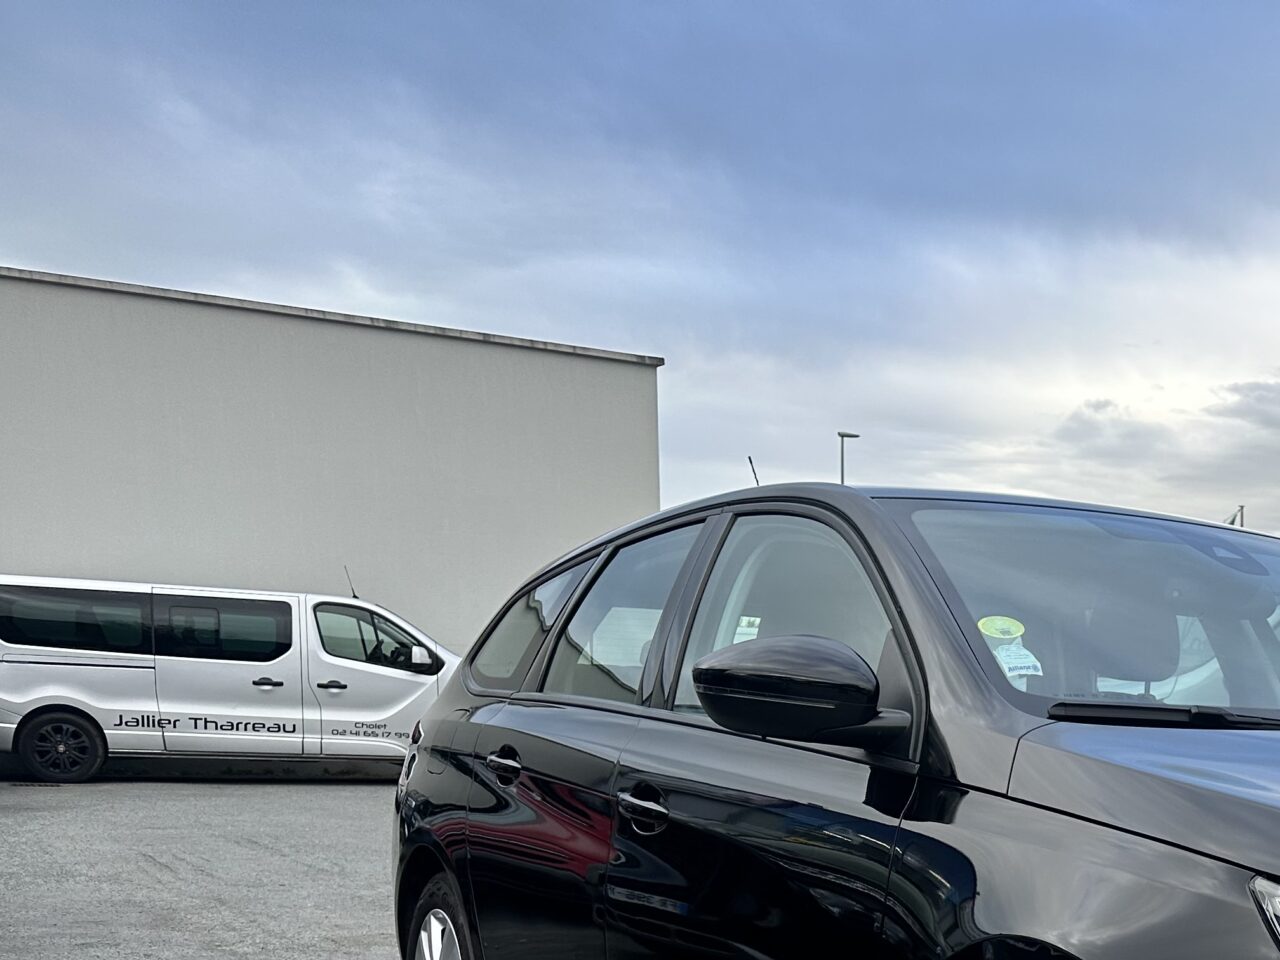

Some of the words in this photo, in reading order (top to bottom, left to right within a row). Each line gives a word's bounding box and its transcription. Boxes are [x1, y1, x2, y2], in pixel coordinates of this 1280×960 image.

[113, 714, 180, 729] Jallier
[188, 717, 297, 734] Tharreau
[354, 721, 387, 730] Cholet
[331, 728, 347, 736] 02
[349, 729, 360, 737] 41
[363, 730, 379, 738] 65
[394, 731, 410, 739] 99
